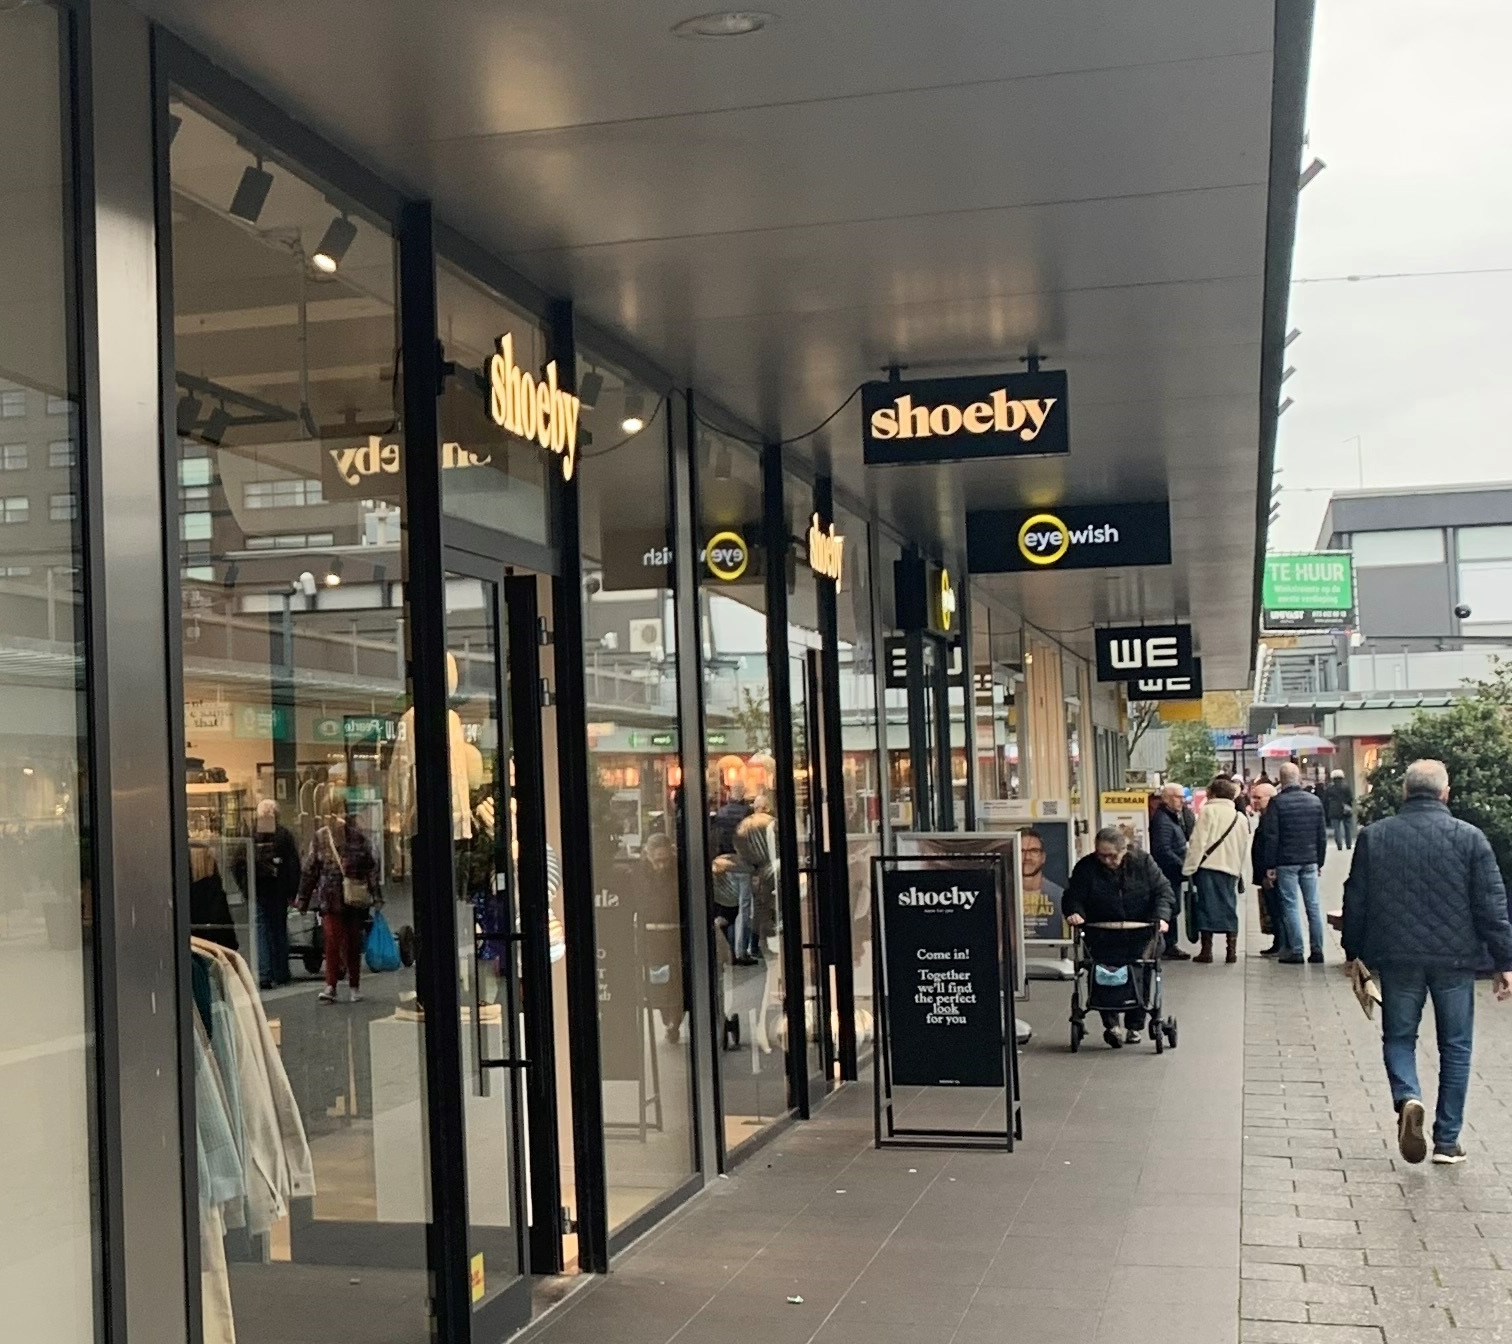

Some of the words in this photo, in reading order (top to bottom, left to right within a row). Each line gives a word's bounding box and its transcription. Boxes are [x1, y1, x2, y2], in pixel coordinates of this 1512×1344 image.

[491, 331, 580, 482] shoeby
[871, 388, 1057, 441] shoeby
[810, 512, 844, 594] shoeby
[1268, 562, 1291, 581] TE
[1295, 563, 1344, 581] HUUR
[1110, 637, 1178, 669] WE
[898, 886, 980, 910] shoeby
[916, 948, 951, 960] Come
[953, 948, 970, 960] in!
[917, 969, 971, 982] Together
[917, 982, 945, 993] we'll
[948, 982, 973, 993] find
[914, 993, 933, 1003] the
[935, 993, 977, 1006] perfect
[933, 1003, 960, 1014] look
[926, 1013, 943, 1024] for
[945, 1016, 967, 1025] you
